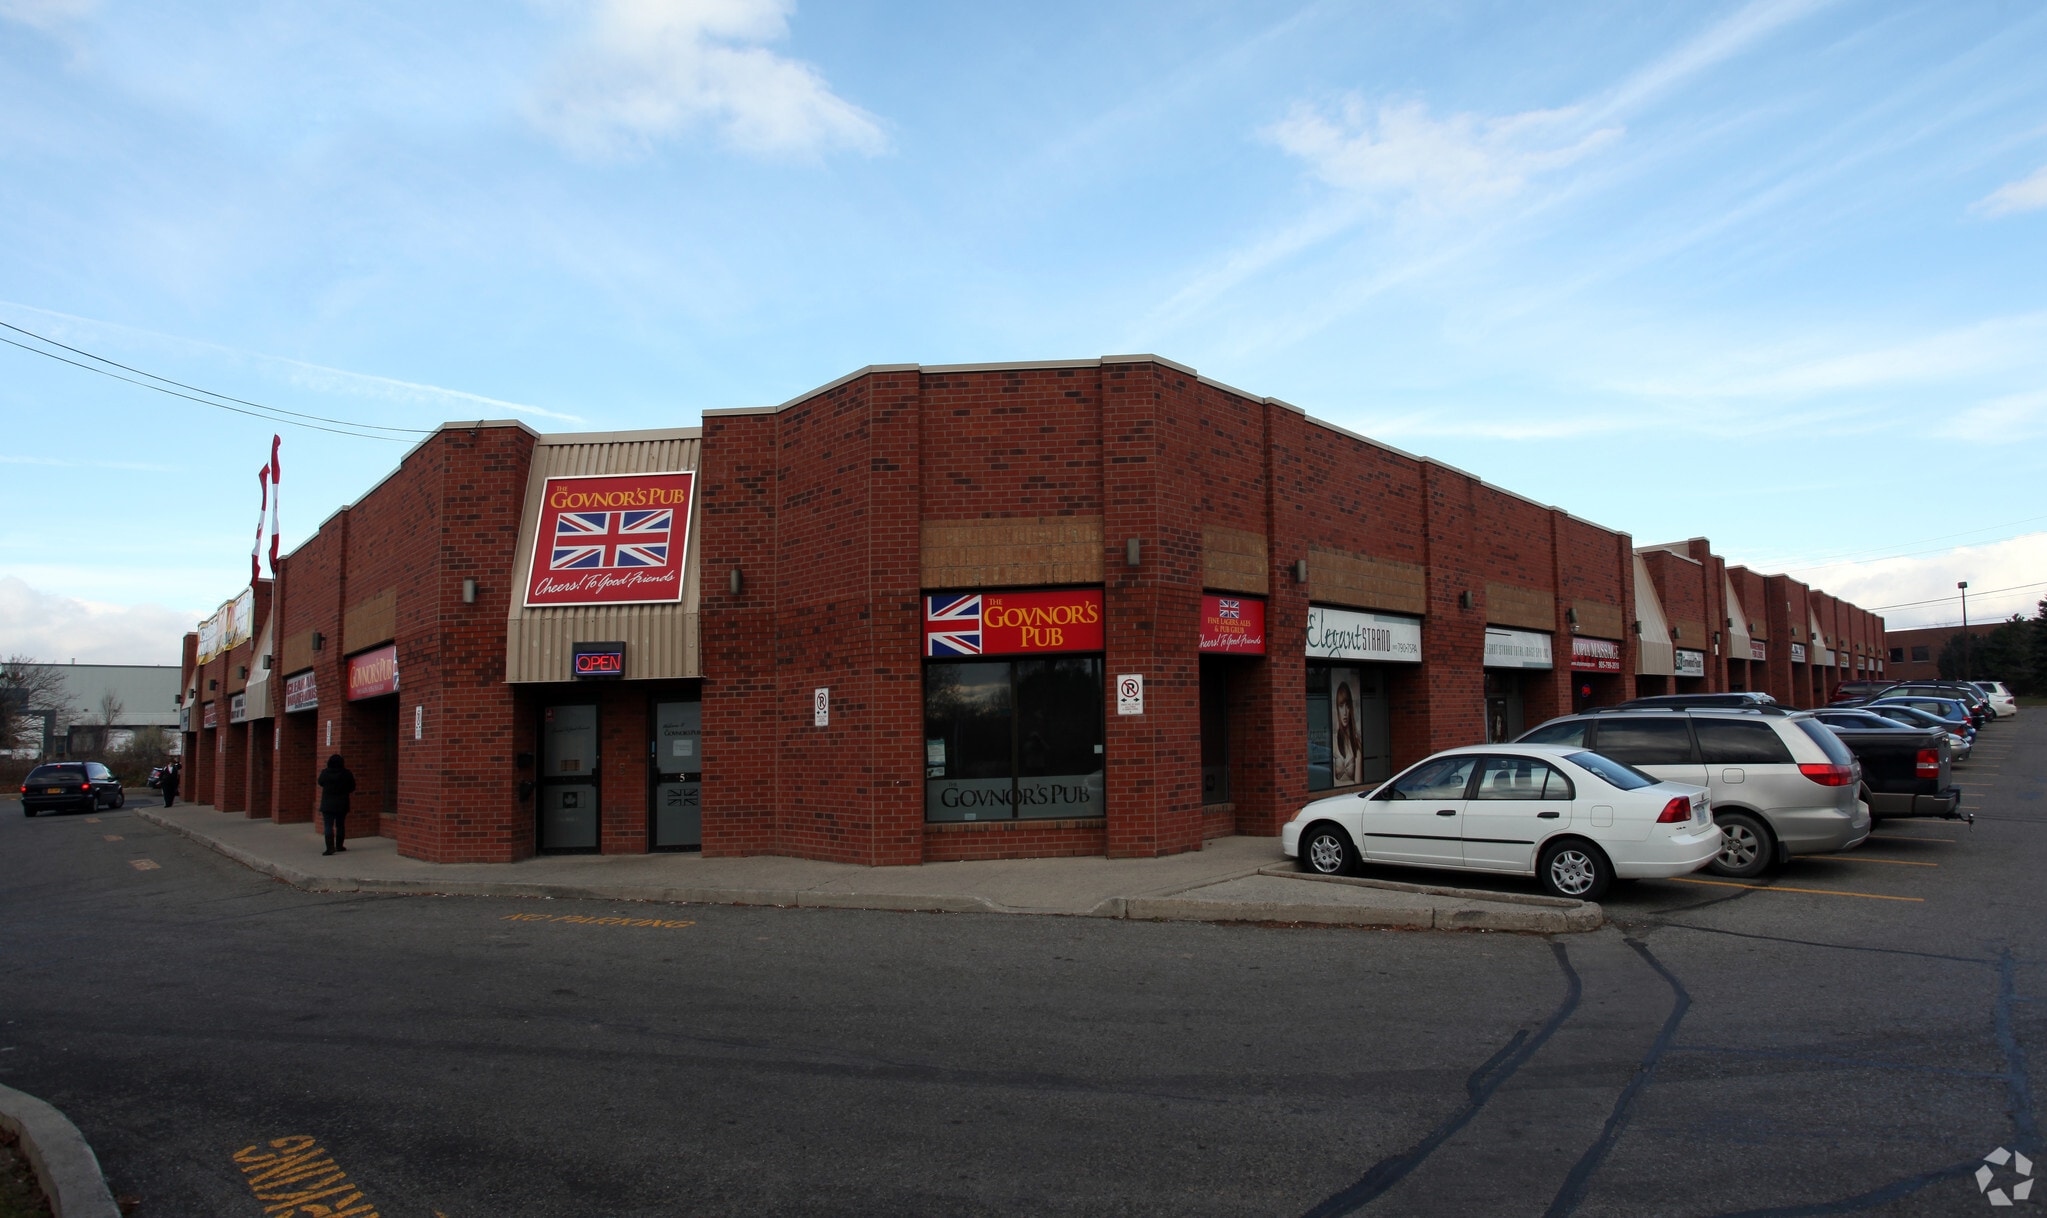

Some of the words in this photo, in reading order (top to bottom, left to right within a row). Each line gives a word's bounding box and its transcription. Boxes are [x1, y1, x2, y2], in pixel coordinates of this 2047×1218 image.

[550, 487, 647, 509] GOVNOR'S
[649, 487, 685, 505] PUB
[534, 574, 586, 596] Cheers!
[586, 574, 598, 590] To
[596, 573, 627, 594] Good
[628, 569, 675, 588] Friends
[989, 598, 1003, 606] THE
[983, 601, 1098, 628] GOVNOR'S
[1207, 617, 1220, 625] FINE
[1020, 626, 1064, 647] PUB
[1220, 625, 1230, 633] PUB
[1306, 609, 1363, 658] Elegant
[1362, 627, 1391, 652] STRAND
[1199, 633, 1221, 649] heers!
[1591, 642, 1620, 659] MASSAGE
[577, 655, 621, 671] OPEN
[679, 773, 686, 782] 5
[941, 783, 1047, 808] GOVNOR'S
[1051, 784, 1090, 804] PUB
